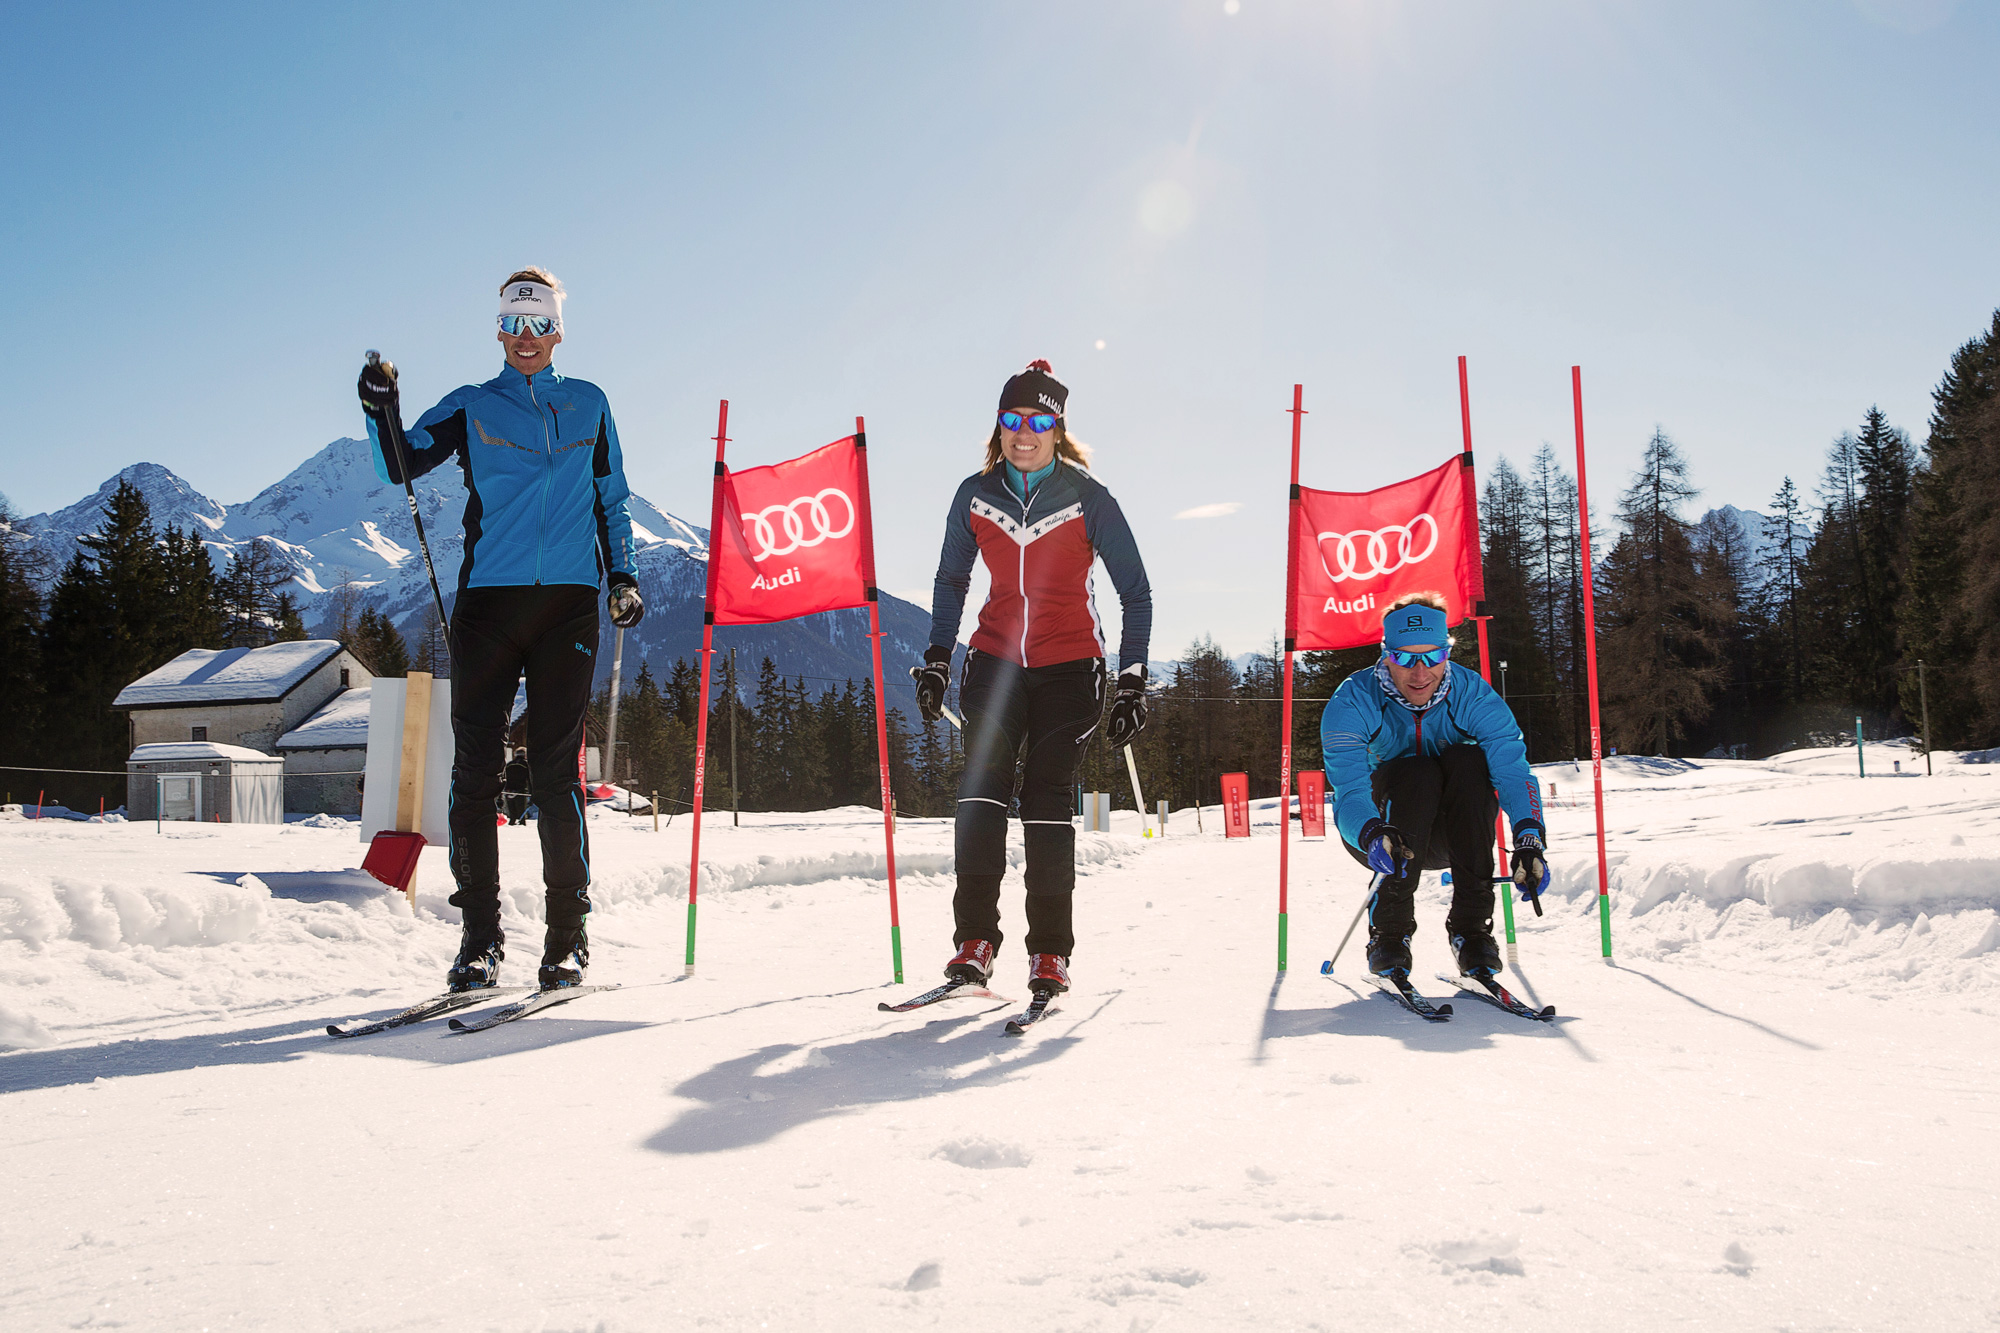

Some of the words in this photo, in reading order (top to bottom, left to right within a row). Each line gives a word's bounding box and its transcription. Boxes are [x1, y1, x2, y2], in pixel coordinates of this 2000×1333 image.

[750, 566, 801, 590] Audi
[1322, 592, 1375, 614] Audi
[1398, 627, 1434, 635] salomon
[695, 748, 704, 793] LISKI
[1591, 730, 1600, 777] LISKI
[1281, 748, 1289, 795] LISKI
[1231, 787, 1240, 825] START
[1308, 785, 1316, 819] ZIEL
[973, 939, 989, 958] alpin
